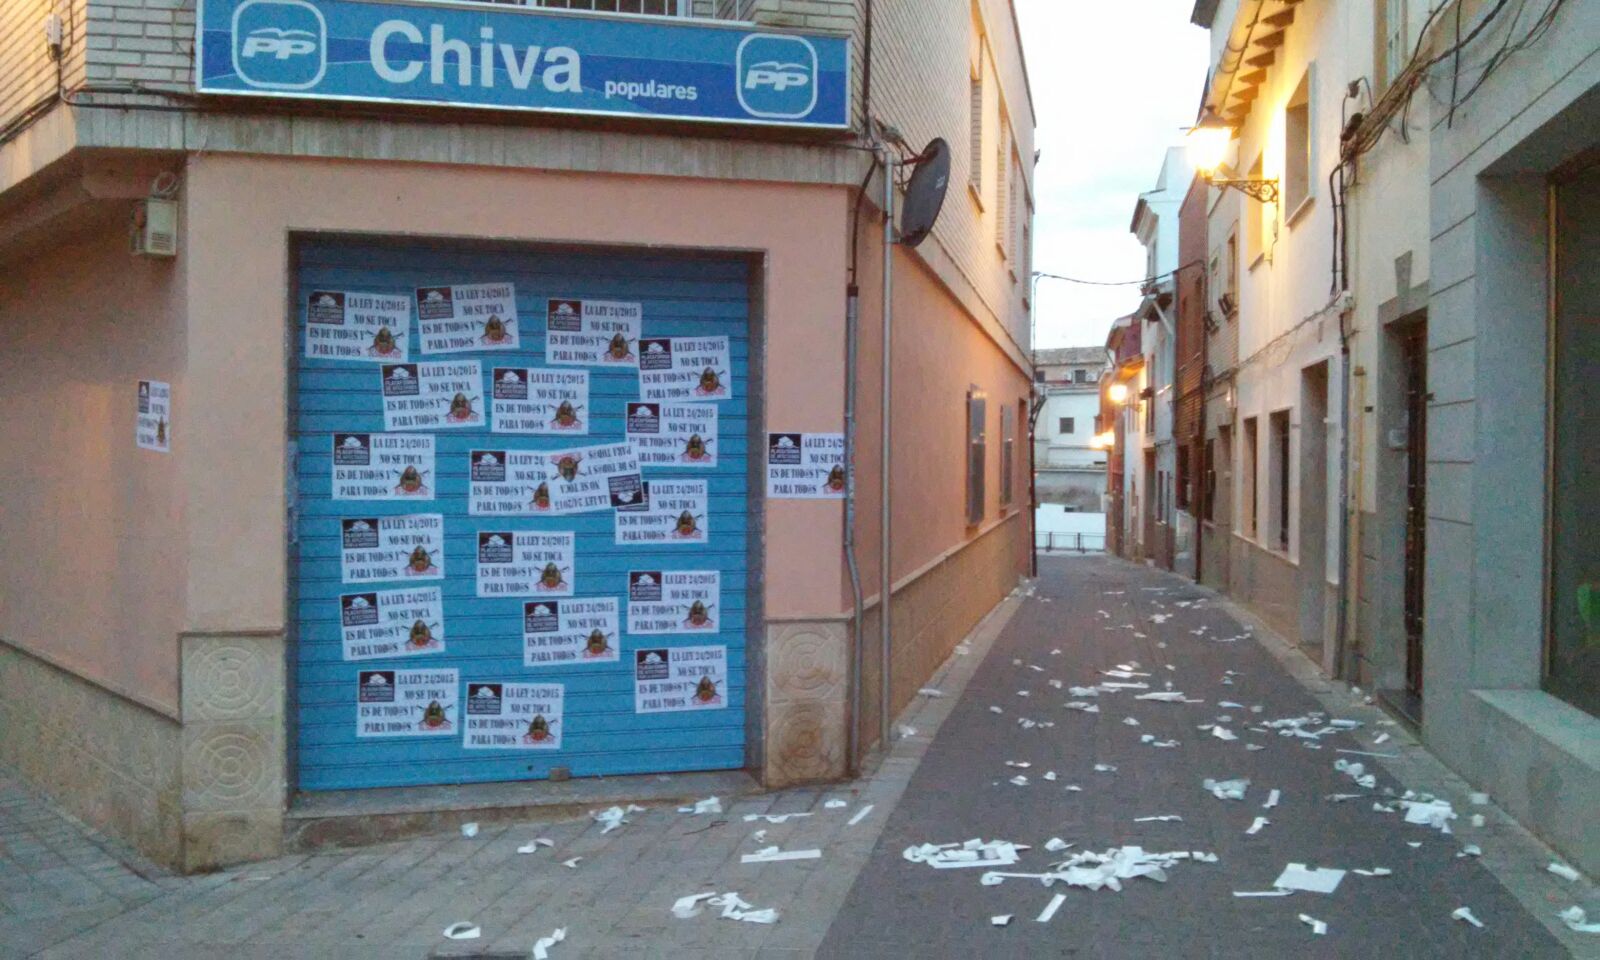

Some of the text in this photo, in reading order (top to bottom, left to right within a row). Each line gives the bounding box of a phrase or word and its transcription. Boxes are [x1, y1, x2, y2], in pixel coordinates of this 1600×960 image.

[242, 36, 317, 60] PP
[369, 20, 582, 93] Chiva
[744, 68, 810, 91] PP
[604, 78, 698, 101] populares
[466, 289, 479, 299] LEY
[360, 298, 372, 308] LEY
[462, 305, 473, 315] NO
[474, 305, 484, 314] SE
[485, 304, 504, 314] TOCA
[595, 306, 607, 315] LEY
[354, 314, 364, 324] NO
[366, 315, 376, 325] SE
[377, 316, 396, 326] TOCA
[422, 324, 431, 333] ES
[433, 323, 443, 332] DE
[590, 321, 599, 330] NO
[601, 321, 610, 331] SE
[612, 322, 629, 332] TOCA
[309, 327, 318, 337] ES
[321, 328, 330, 338] DE
[427, 338, 448, 348] PARA
[550, 335, 558, 344] ES
[560, 335, 569, 344] DE
[313, 344, 333, 354] PARA
[684, 342, 695, 351] LEY
[553, 350, 572, 360] PARA
[680, 357, 689, 366] NO
[691, 357, 700, 366] SE
[701, 356, 718, 365] TOCA
[432, 366, 445, 376] LEY
[542, 373, 553, 383] LEY
[642, 374, 650, 383] ES
[652, 374, 661, 383] DE
[428, 383, 438, 392] NO
[440, 382, 450, 392] SE
[451, 381, 470, 391] TOCA
[537, 389, 576, 399] NO SE TOCA
[647, 388, 665, 398] PARA
[387, 401, 396, 410] ES
[398, 400, 408, 409] DE
[495, 403, 503, 412] ES
[506, 404, 515, 413] DE
[392, 416, 412, 426] PARA
[499, 419, 518, 428] PARA
[385, 438, 397, 447] LEY
[380, 454, 421, 464] NO SE TOCA
[336, 470, 345, 479] ES
[347, 470, 357, 479] DE
[781, 468, 789, 477] DE
[340, 486, 360, 495] PARA
[393, 519, 405, 529] LEY
[388, 535, 398, 545] NO
[400, 535, 410, 544] SE
[412, 534, 430, 544] TOCA
[527, 536, 539, 545] LEY
[345, 553, 354, 562] ES
[357, 552, 366, 562] DE
[522, 551, 561, 560] NO SE TOCA
[350, 568, 370, 578] PARA
[480, 567, 489, 576] ES
[491, 567, 500, 576] DE
[484, 583, 503, 592] PARA
[641, 605, 650, 614] DE
[357, 629, 367, 639] DE
